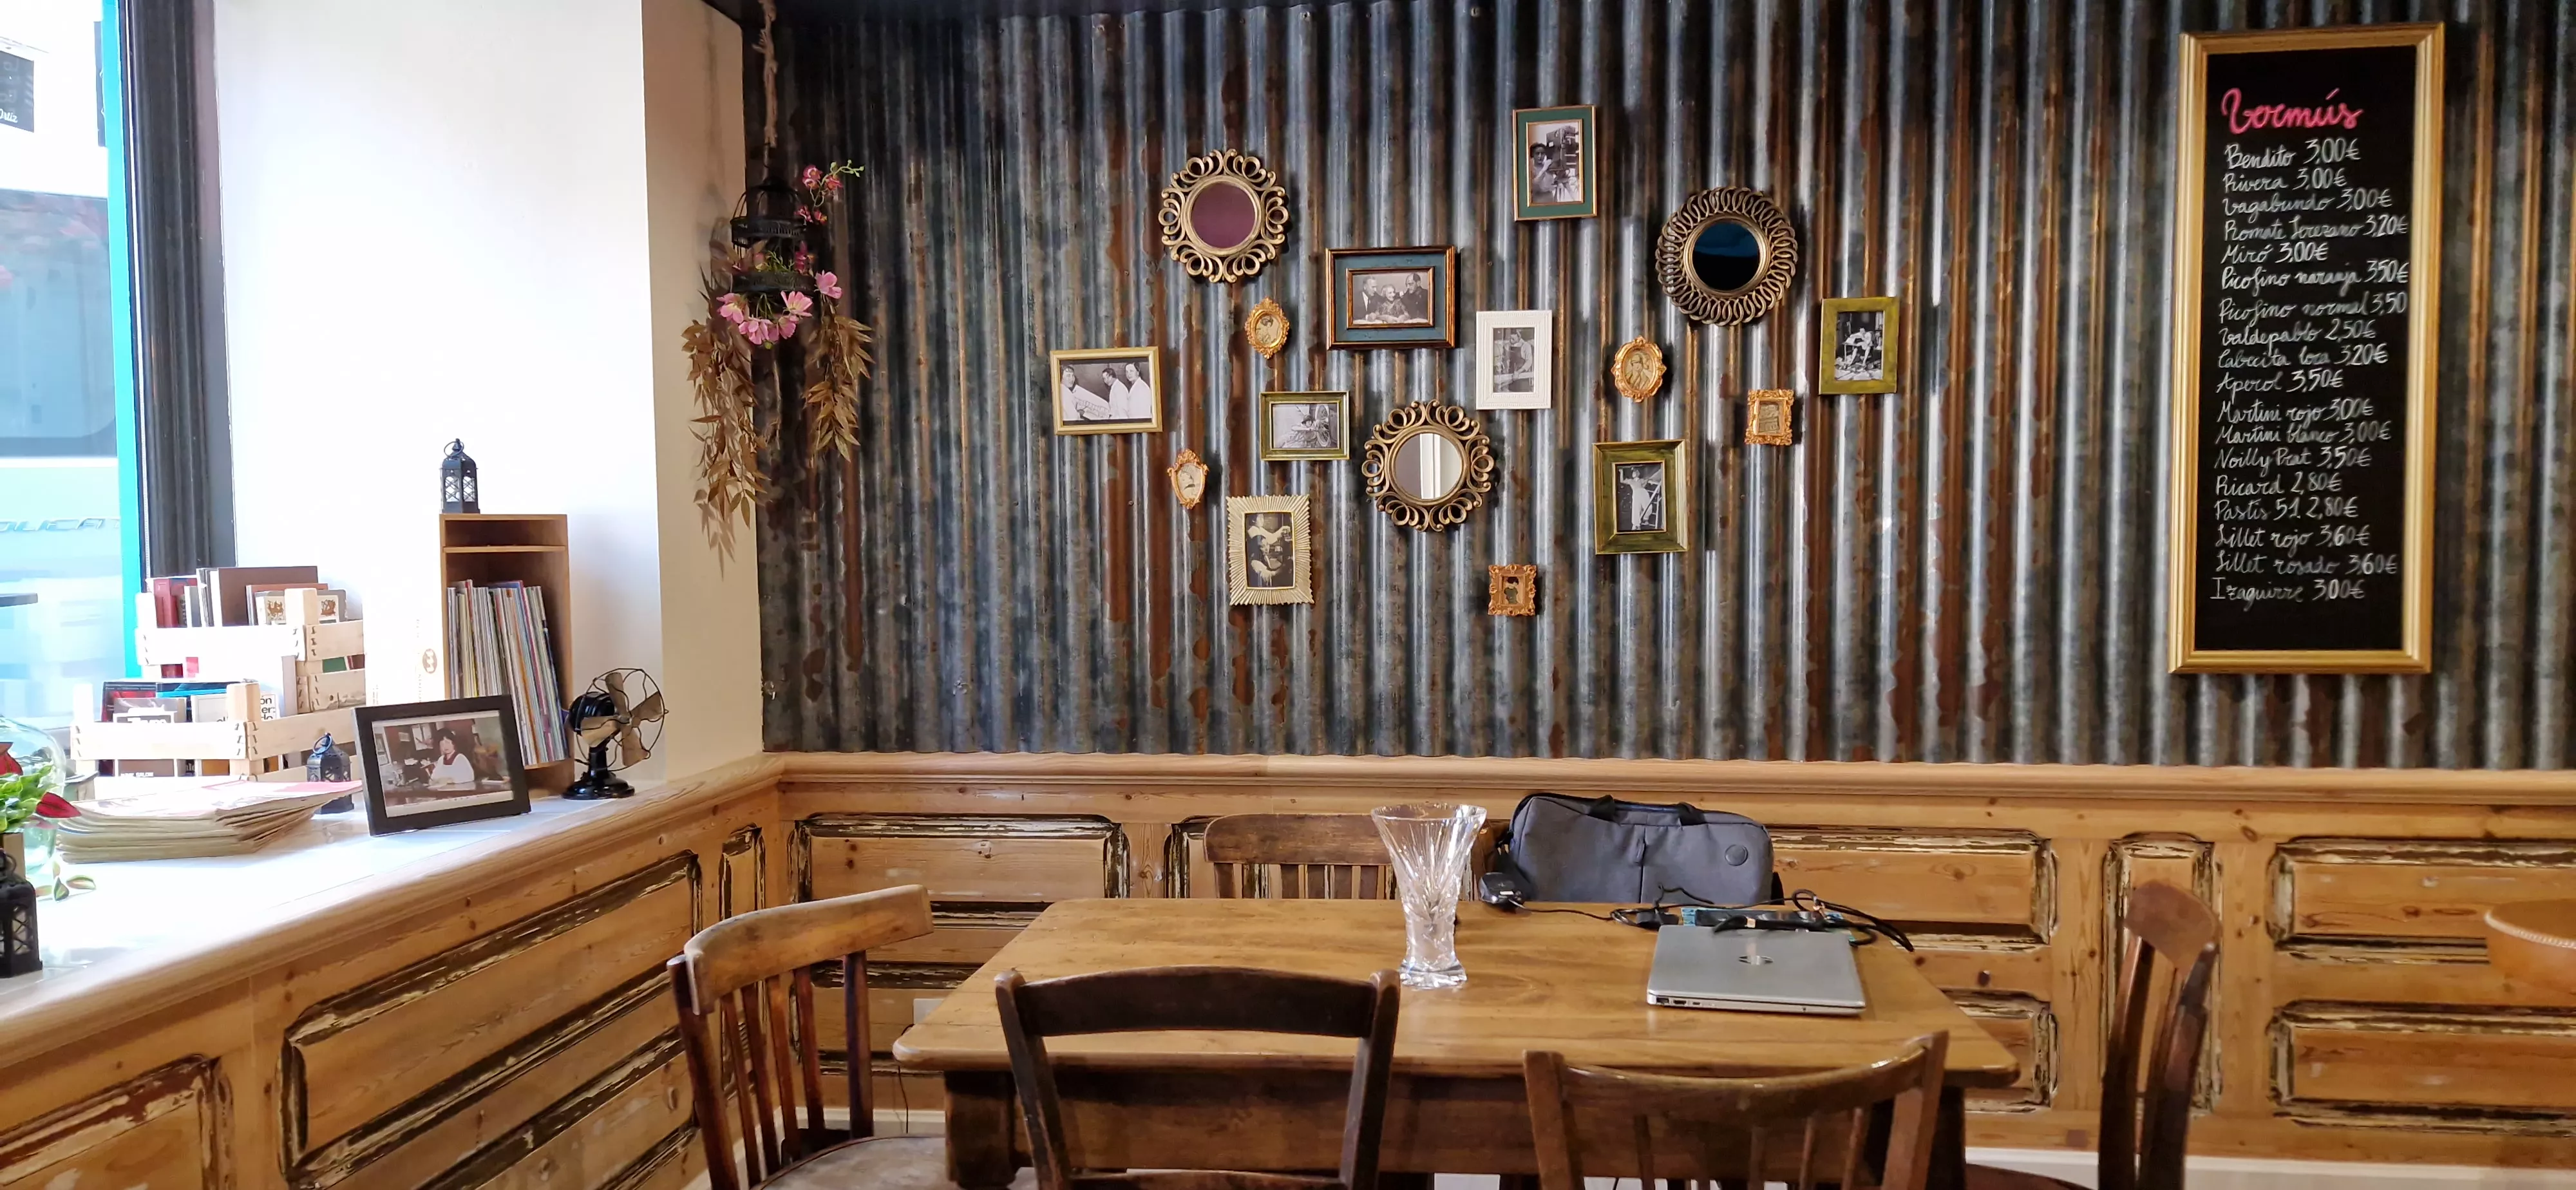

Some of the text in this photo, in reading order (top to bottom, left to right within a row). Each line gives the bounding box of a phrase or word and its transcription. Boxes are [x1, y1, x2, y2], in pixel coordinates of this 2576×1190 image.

[2224, 143, 2296, 169] Bendito
[2222, 173, 2289, 193] Rivera
[2221, 244, 2273, 263] Miró
[2302, 290, 2369, 316] normal
[2215, 370, 2284, 404] Aperol
[2217, 399, 2282, 424] Martini
[2286, 405, 2326, 429] rojo
[2215, 425, 2281, 444] Martini
[2286, 422, 2340, 443] blanco
[2214, 448, 2271, 477] Noilly
[2215, 474, 2284, 496] Ricard
[2214, 499, 2272, 520] Pastis
[2269, 529, 2314, 558] rojo
[2273, 555, 2340, 575] rosado
